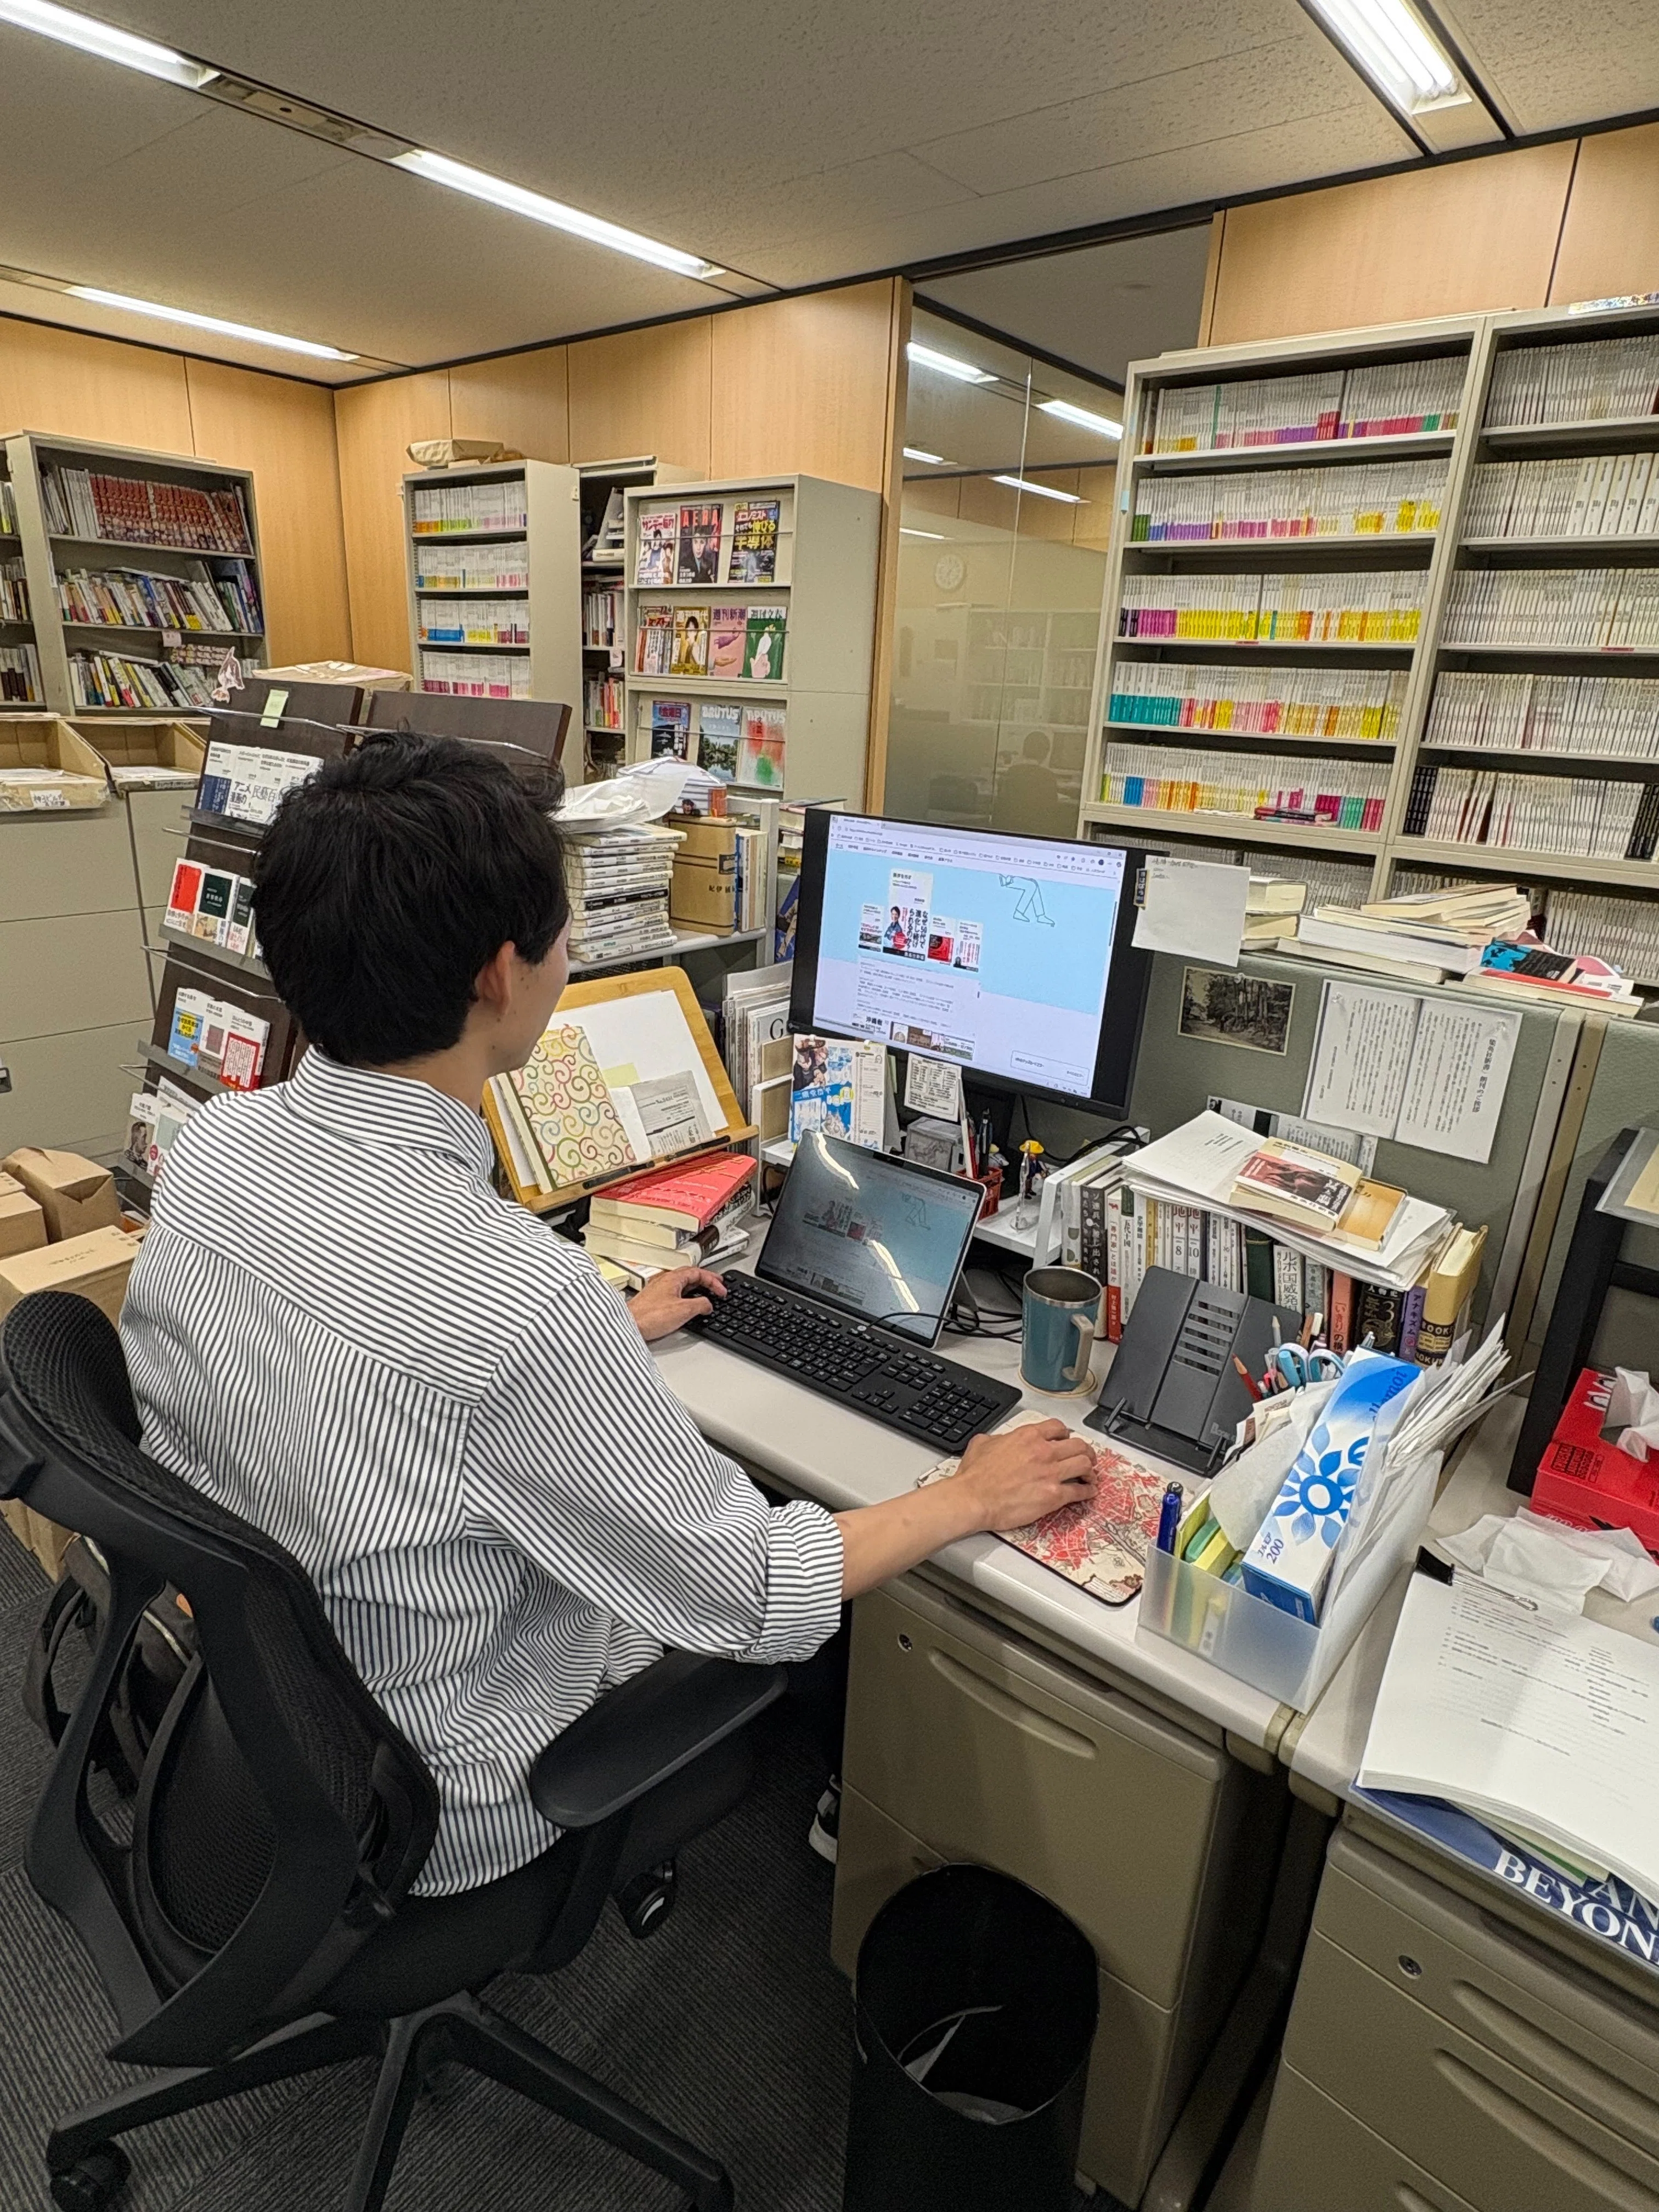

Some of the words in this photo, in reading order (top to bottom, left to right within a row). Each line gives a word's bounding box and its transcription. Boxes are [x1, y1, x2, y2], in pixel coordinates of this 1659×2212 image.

[681, 509, 719, 528] AERA
[701, 706, 740, 720] BRUTUS
[1175, 1245, 1182, 1256] 8
[1188, 1246, 1199, 1258] 10
[1383, 1300, 1395, 1319] 3
[1333, 1301, 1347, 1354] 「いきり」の構
[1266, 1538, 1285, 1565] 200
[1493, 1849, 1659, 1965] BEYON
